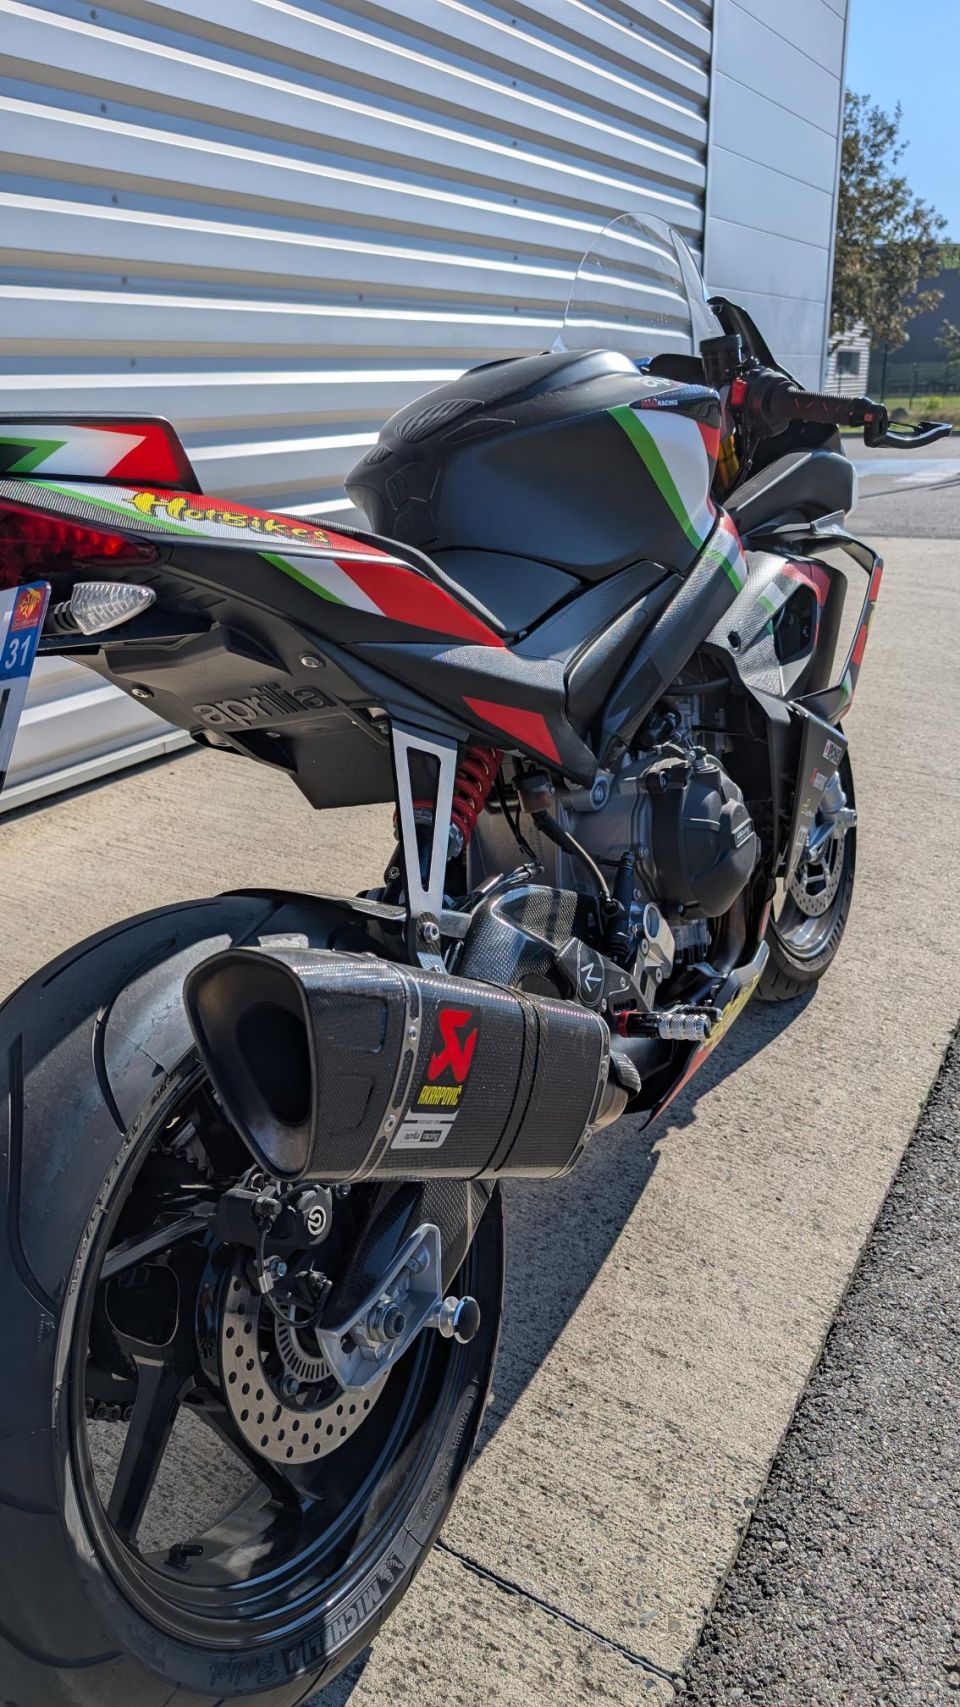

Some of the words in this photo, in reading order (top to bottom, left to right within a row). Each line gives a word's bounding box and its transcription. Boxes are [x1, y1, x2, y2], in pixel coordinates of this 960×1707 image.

[122, 492, 332, 545] HotBikes
[5, 635, 31, 669] 31
[193, 682, 337, 726] aprilia
